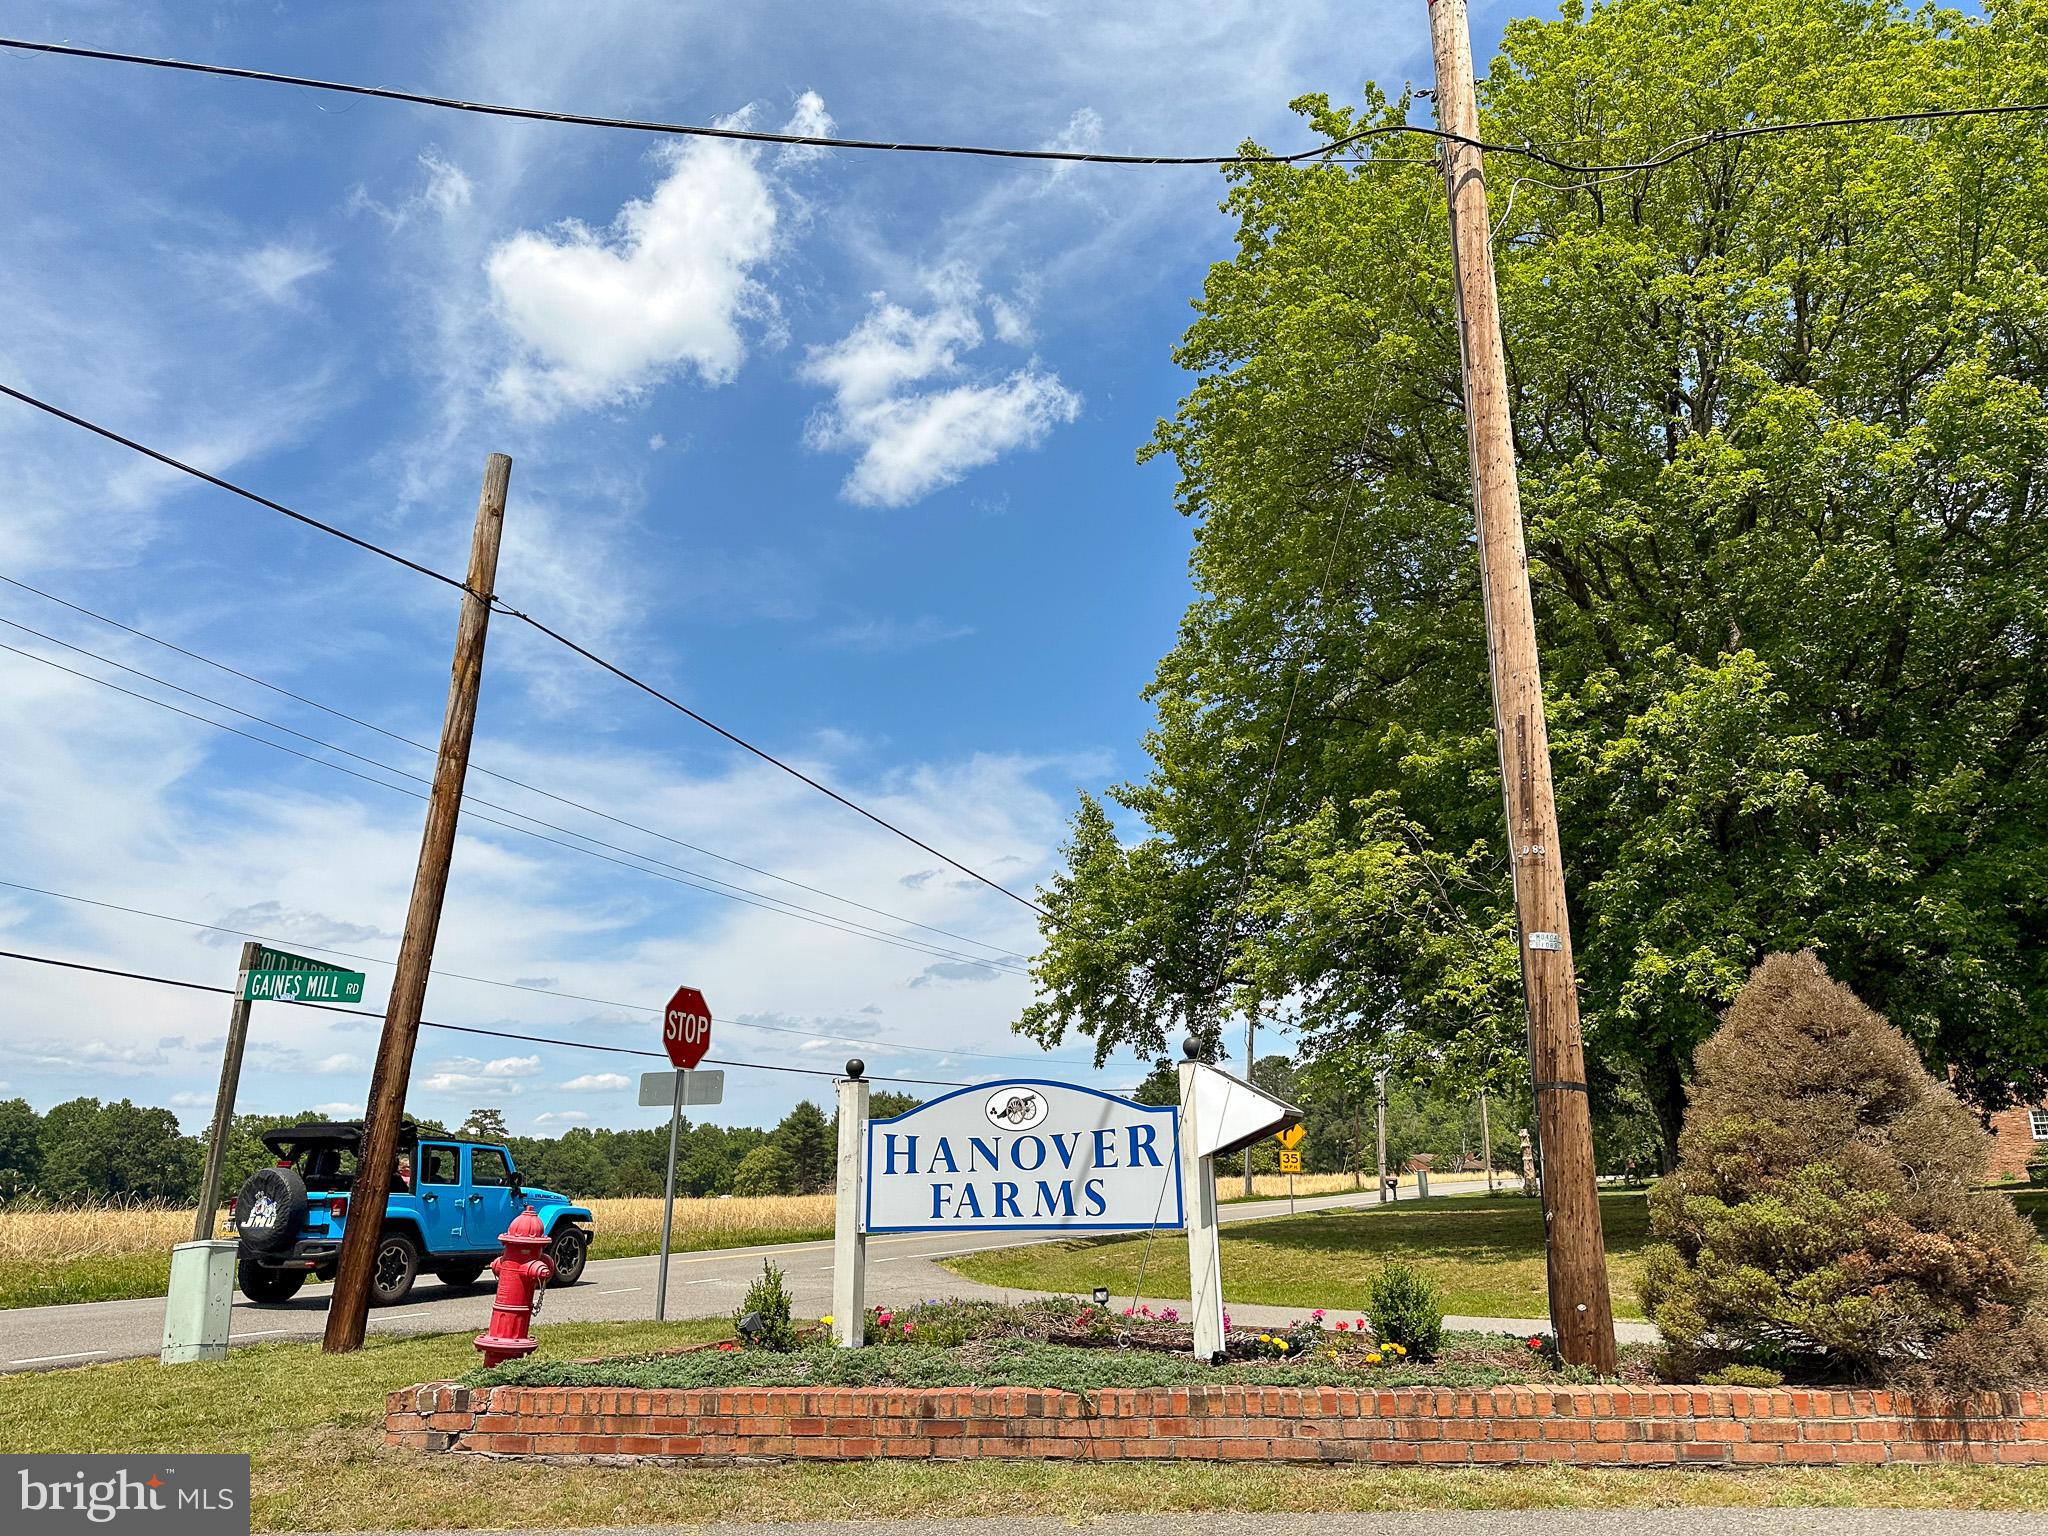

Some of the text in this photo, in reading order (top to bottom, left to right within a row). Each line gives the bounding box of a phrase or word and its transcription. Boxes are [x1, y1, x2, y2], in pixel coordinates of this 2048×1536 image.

[252, 974, 359, 997] GAINES MILL RD
[666, 1010, 708, 1044] STOP
[882, 1123, 1164, 1175] HANOVER
[1282, 1153, 1299, 1164] 35
[929, 1178, 1107, 1219] FARMS
[241, 1213, 277, 1228] JMU
